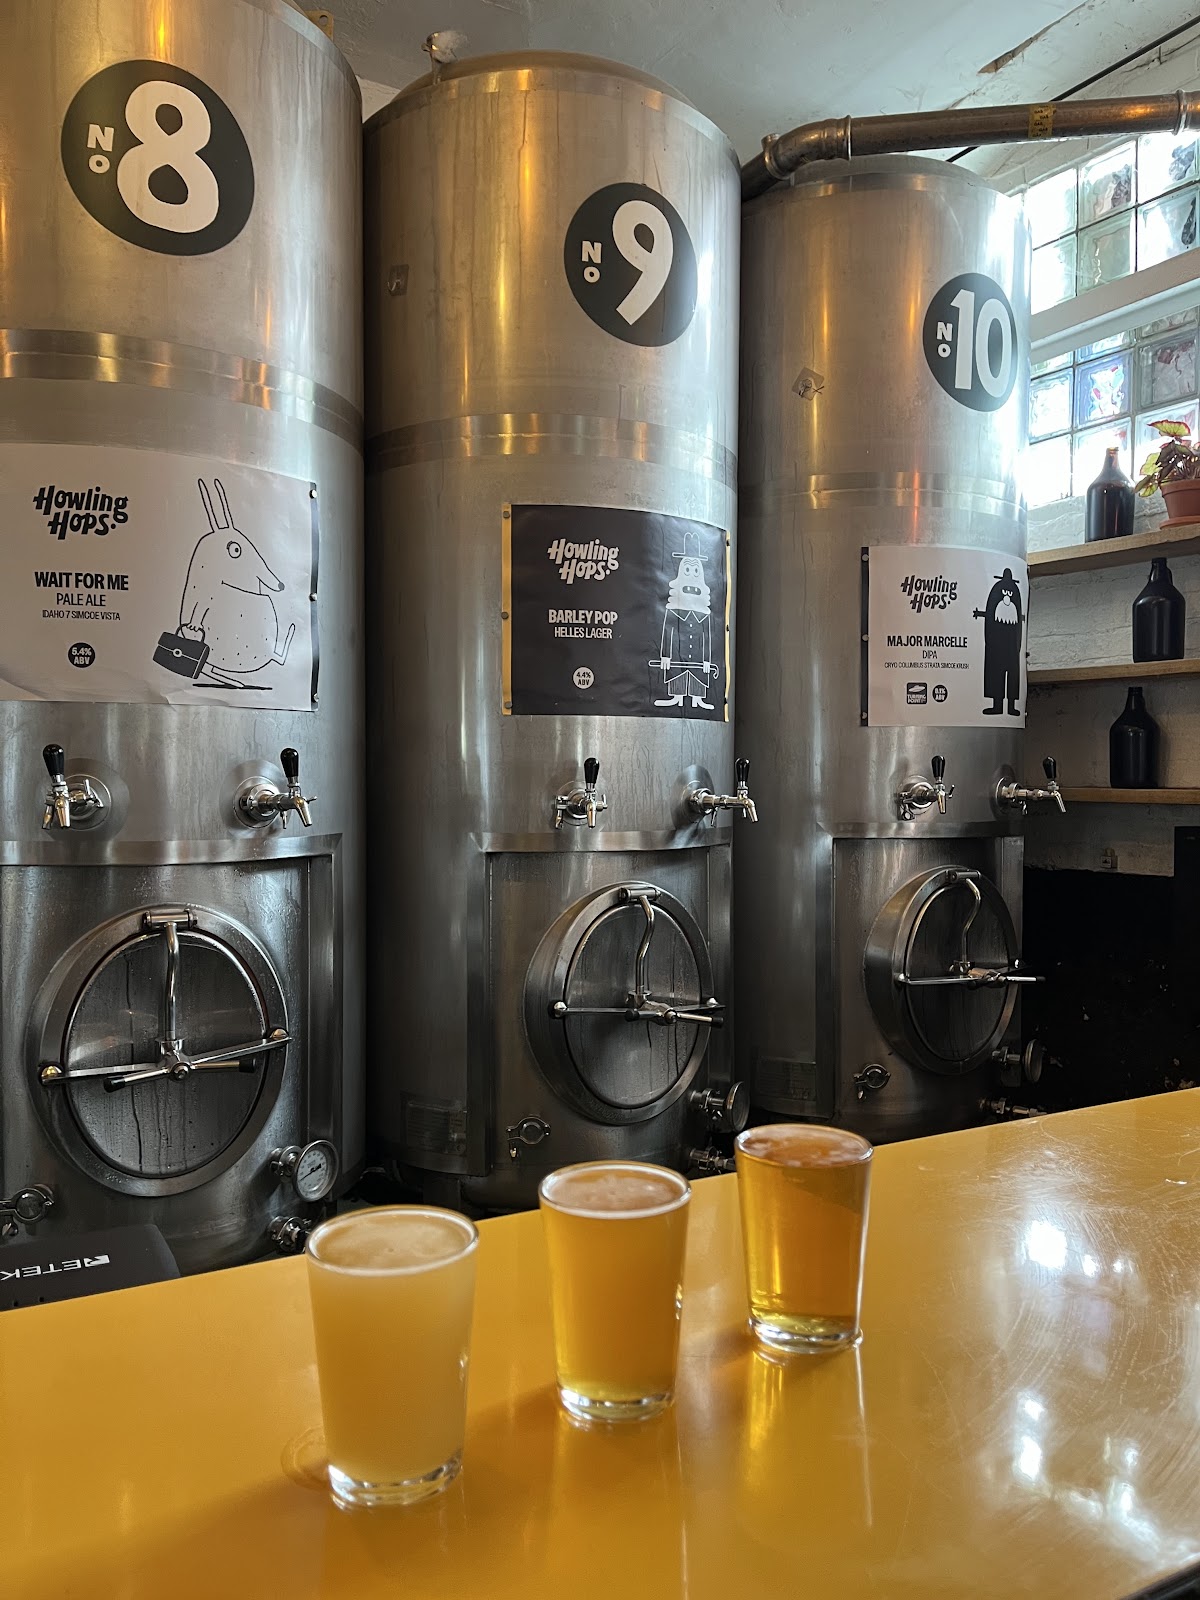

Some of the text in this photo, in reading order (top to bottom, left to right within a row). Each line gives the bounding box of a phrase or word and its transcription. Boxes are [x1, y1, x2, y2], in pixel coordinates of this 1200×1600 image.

[116, 80, 220, 234] 8
[612, 200, 674, 326] 9
[950, 289, 1012, 398] 10
[33, 485, 129, 523] Howling
[547, 538, 619, 570] Howling
[34, 571, 129, 590] WAIT FOR ME
[900, 575, 958, 600] Howling
[56, 592, 106, 606] PALE ALE
[42, 609, 121, 620] IDAHO 7 SIMCOE VISTA
[548, 609, 618, 625] BARLEY POP
[554, 626, 613, 639] HELLES LAGER
[887, 635, 968, 649] MAJOR MARCELLE
[73, 656, 90, 665] ABV
[922, 650, 938, 660] DIPA
